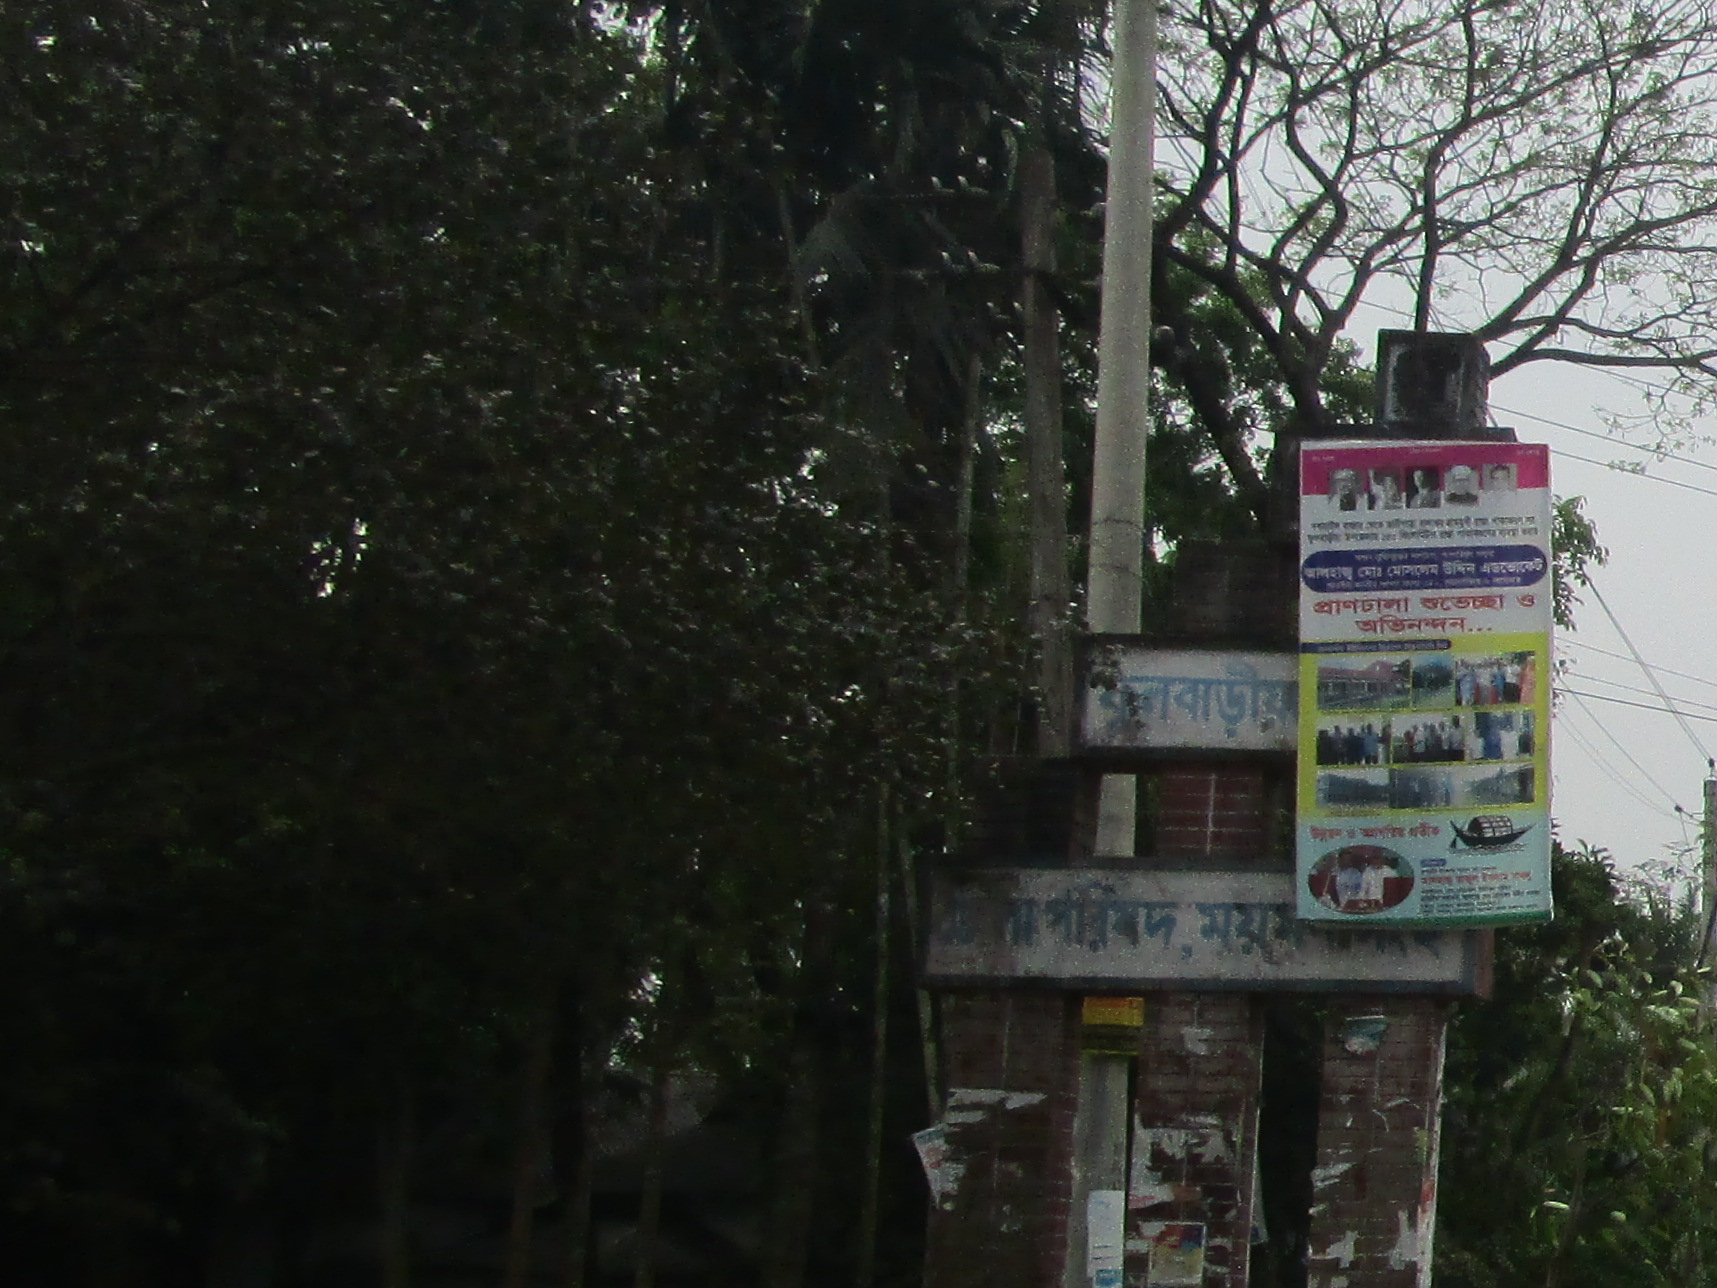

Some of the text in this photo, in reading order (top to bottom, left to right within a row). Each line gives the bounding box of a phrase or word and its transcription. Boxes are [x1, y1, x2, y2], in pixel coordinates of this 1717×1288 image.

[1312, 593, 1536, 615] প্রাণঢালা শুভেচ্ছা ও
